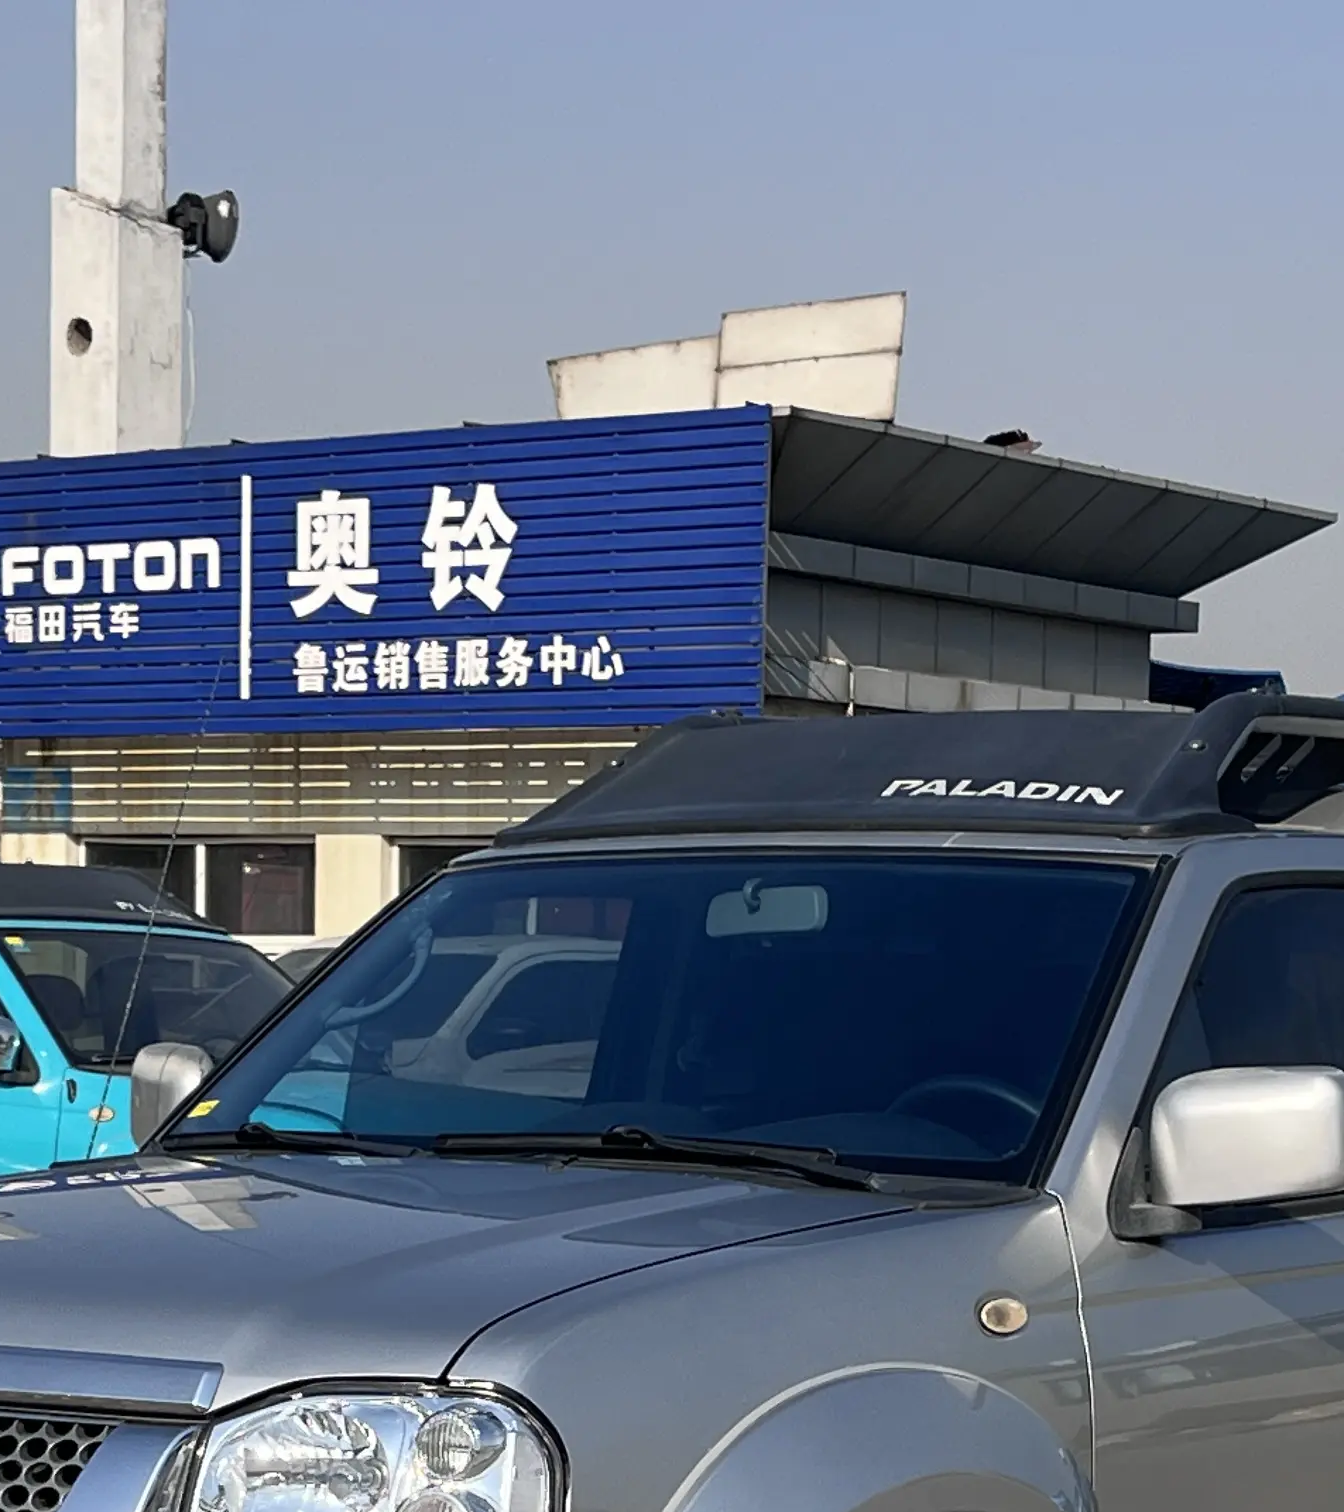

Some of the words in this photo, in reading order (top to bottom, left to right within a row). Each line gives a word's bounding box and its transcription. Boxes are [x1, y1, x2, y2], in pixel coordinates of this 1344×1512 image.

[1, 537, 221, 597] FOTON
[287, 483, 519, 618] 奥铃
[5, 602, 140, 644] 福田汽车
[292, 634, 624, 694] 鲁运销售服务中心
[881, 779, 1124, 806] PALADIN
